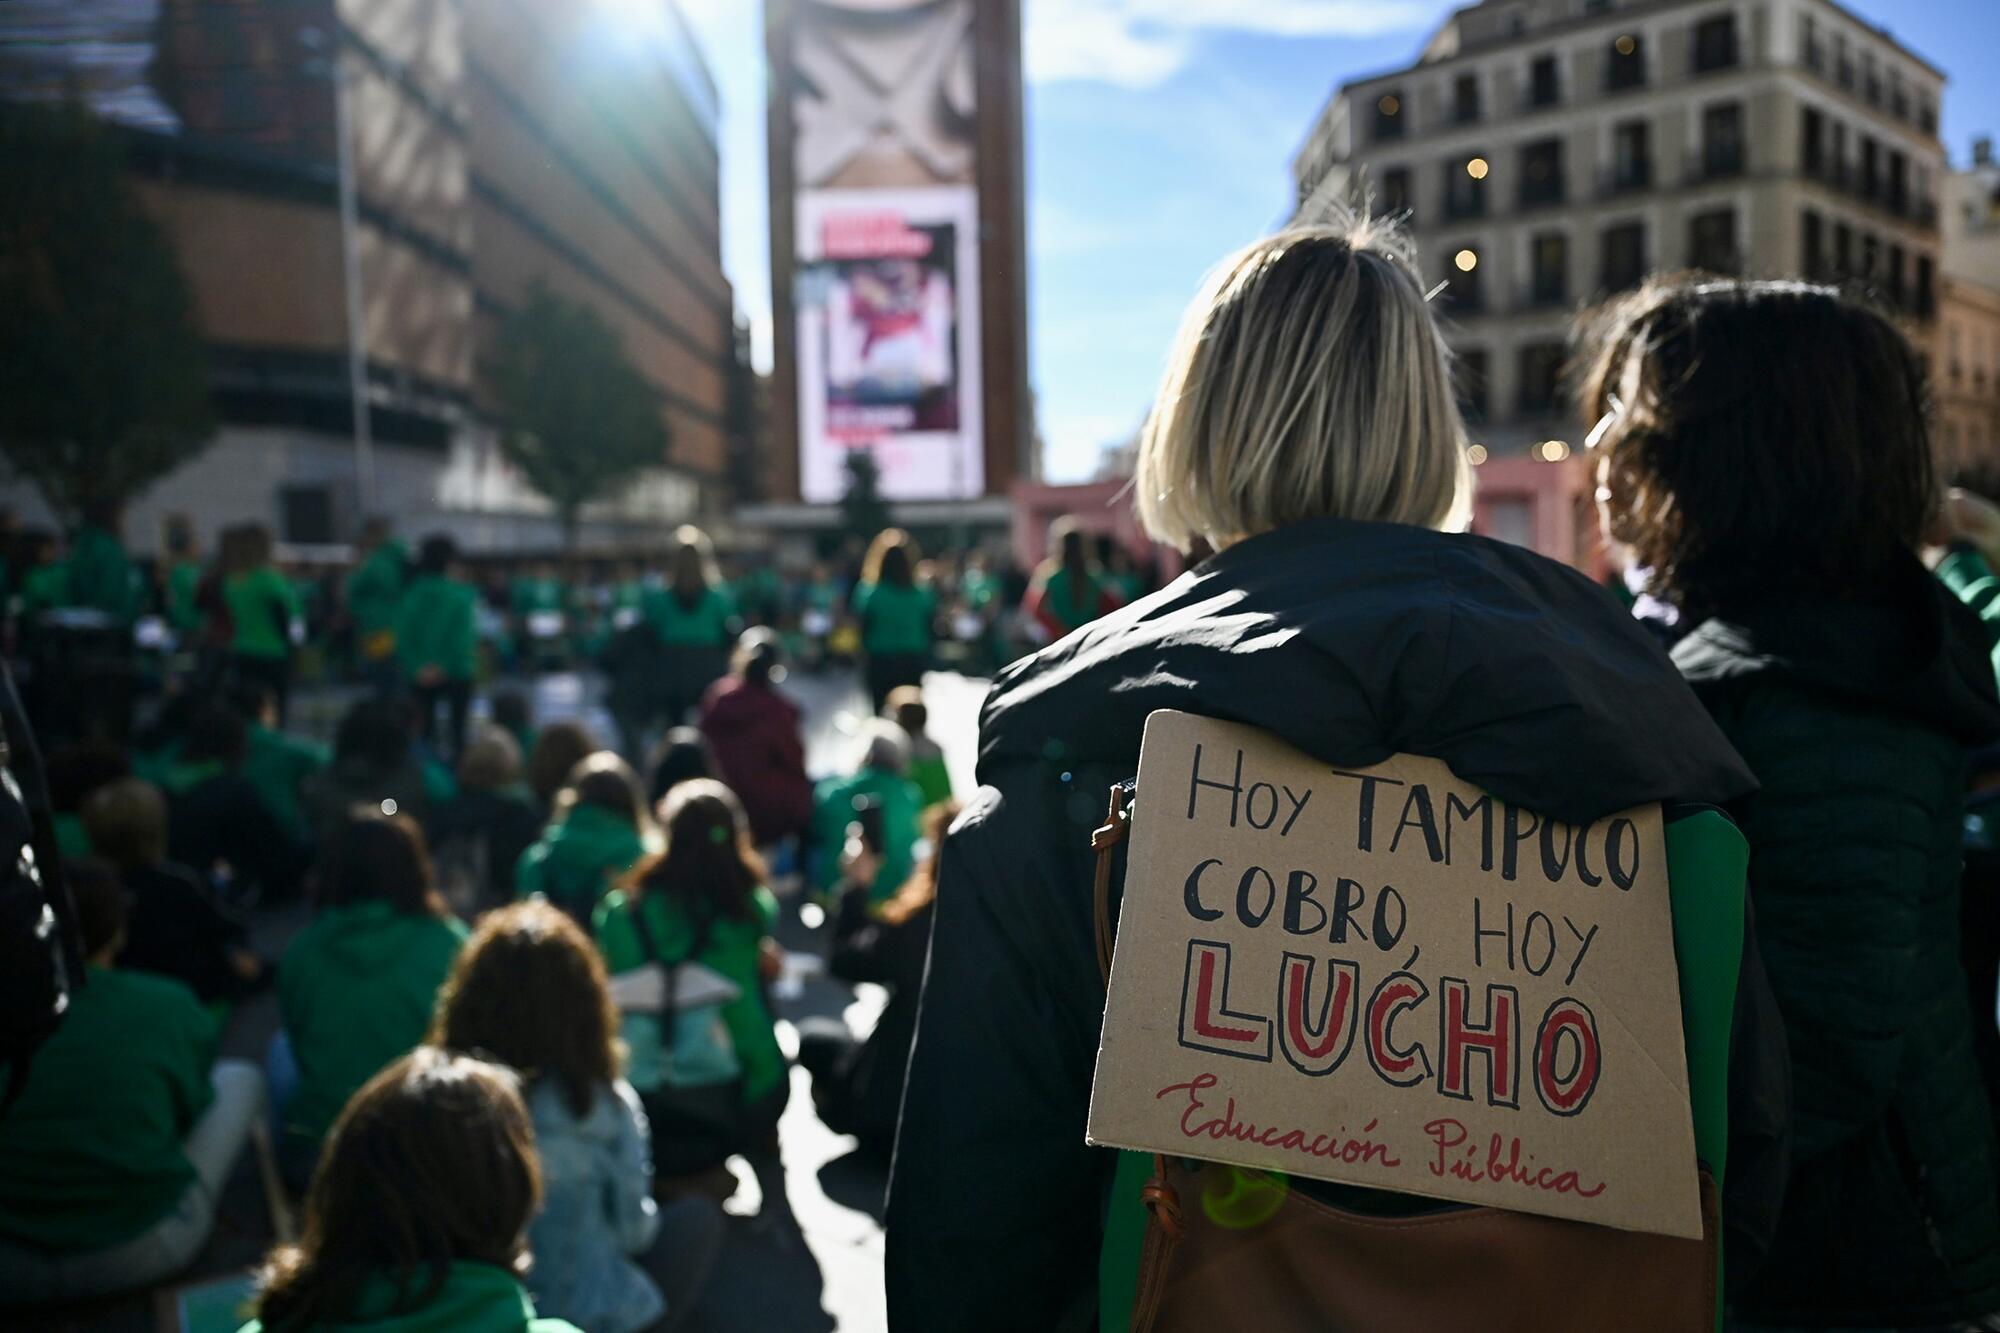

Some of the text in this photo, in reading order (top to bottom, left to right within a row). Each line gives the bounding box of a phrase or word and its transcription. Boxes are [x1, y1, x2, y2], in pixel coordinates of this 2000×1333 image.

[1187, 743, 1640, 891] HOY TAMPOCO
[1183, 858, 1599, 985] COBRO, HOY
[1178, 938, 1602, 1117] LUCHO
[1156, 1072, 1607, 1198] Educación Pública
